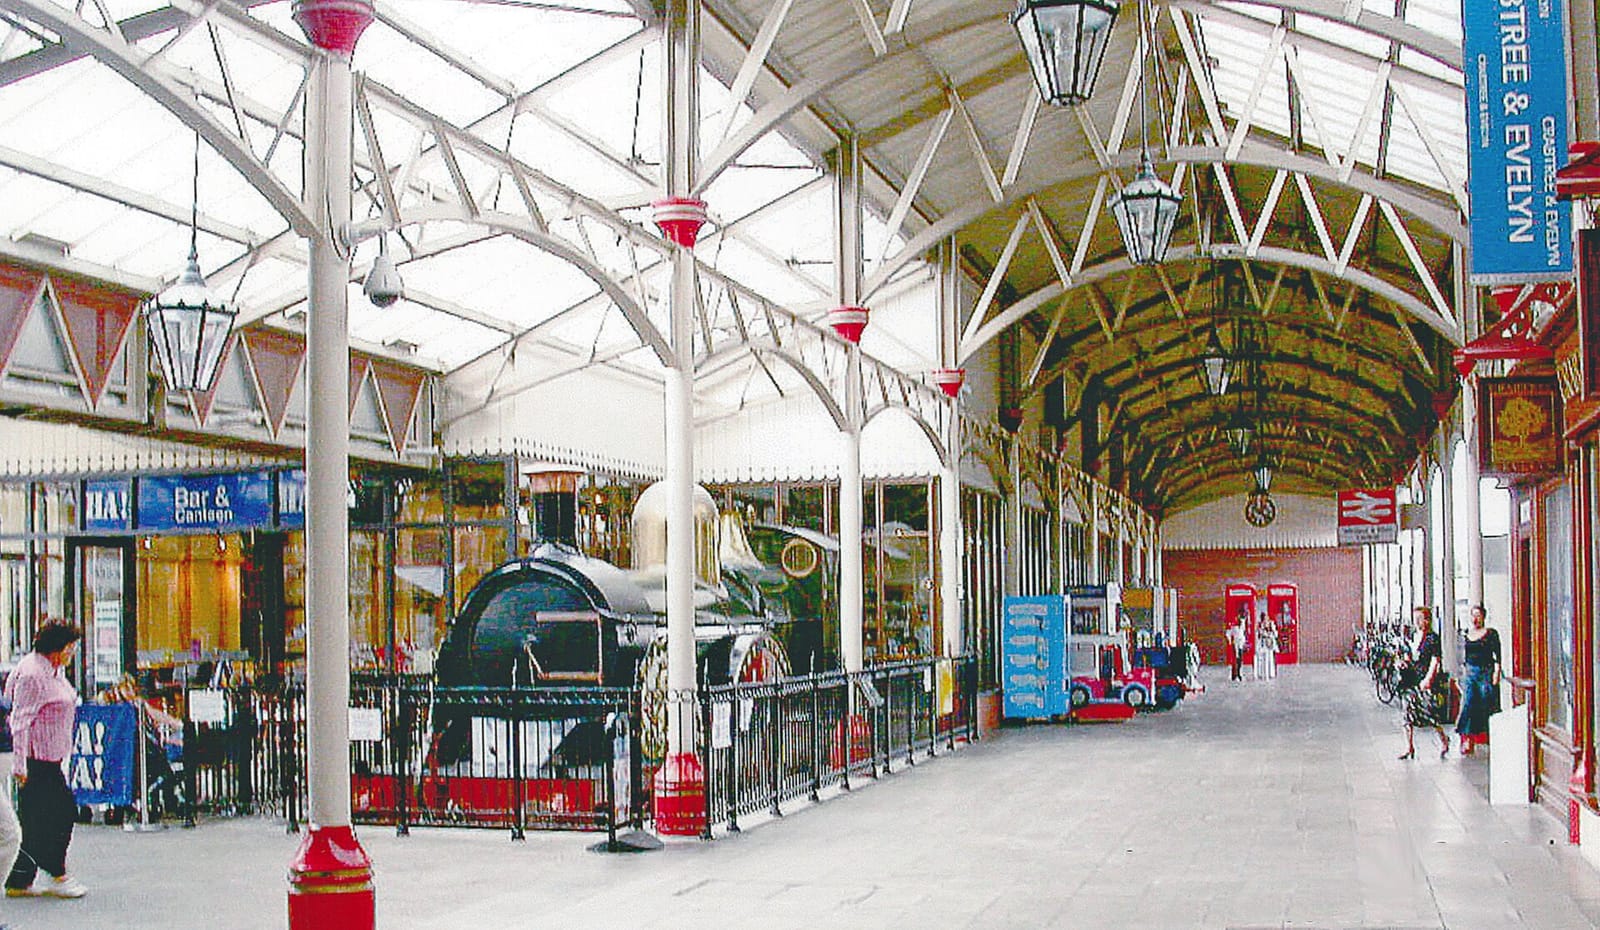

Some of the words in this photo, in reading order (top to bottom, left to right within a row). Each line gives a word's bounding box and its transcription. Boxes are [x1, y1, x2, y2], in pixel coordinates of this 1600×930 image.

[1503, 91, 1529, 116] &
[1505, 124, 1535, 243] EVELYN
[1545, 210, 1561, 266] EVELYN
[86, 490, 129, 520] HA!
[175, 486, 209, 508] Bar
[215, 485, 230, 507] &
[73, 722, 105, 756] A!
[71, 756, 104, 790] A!
